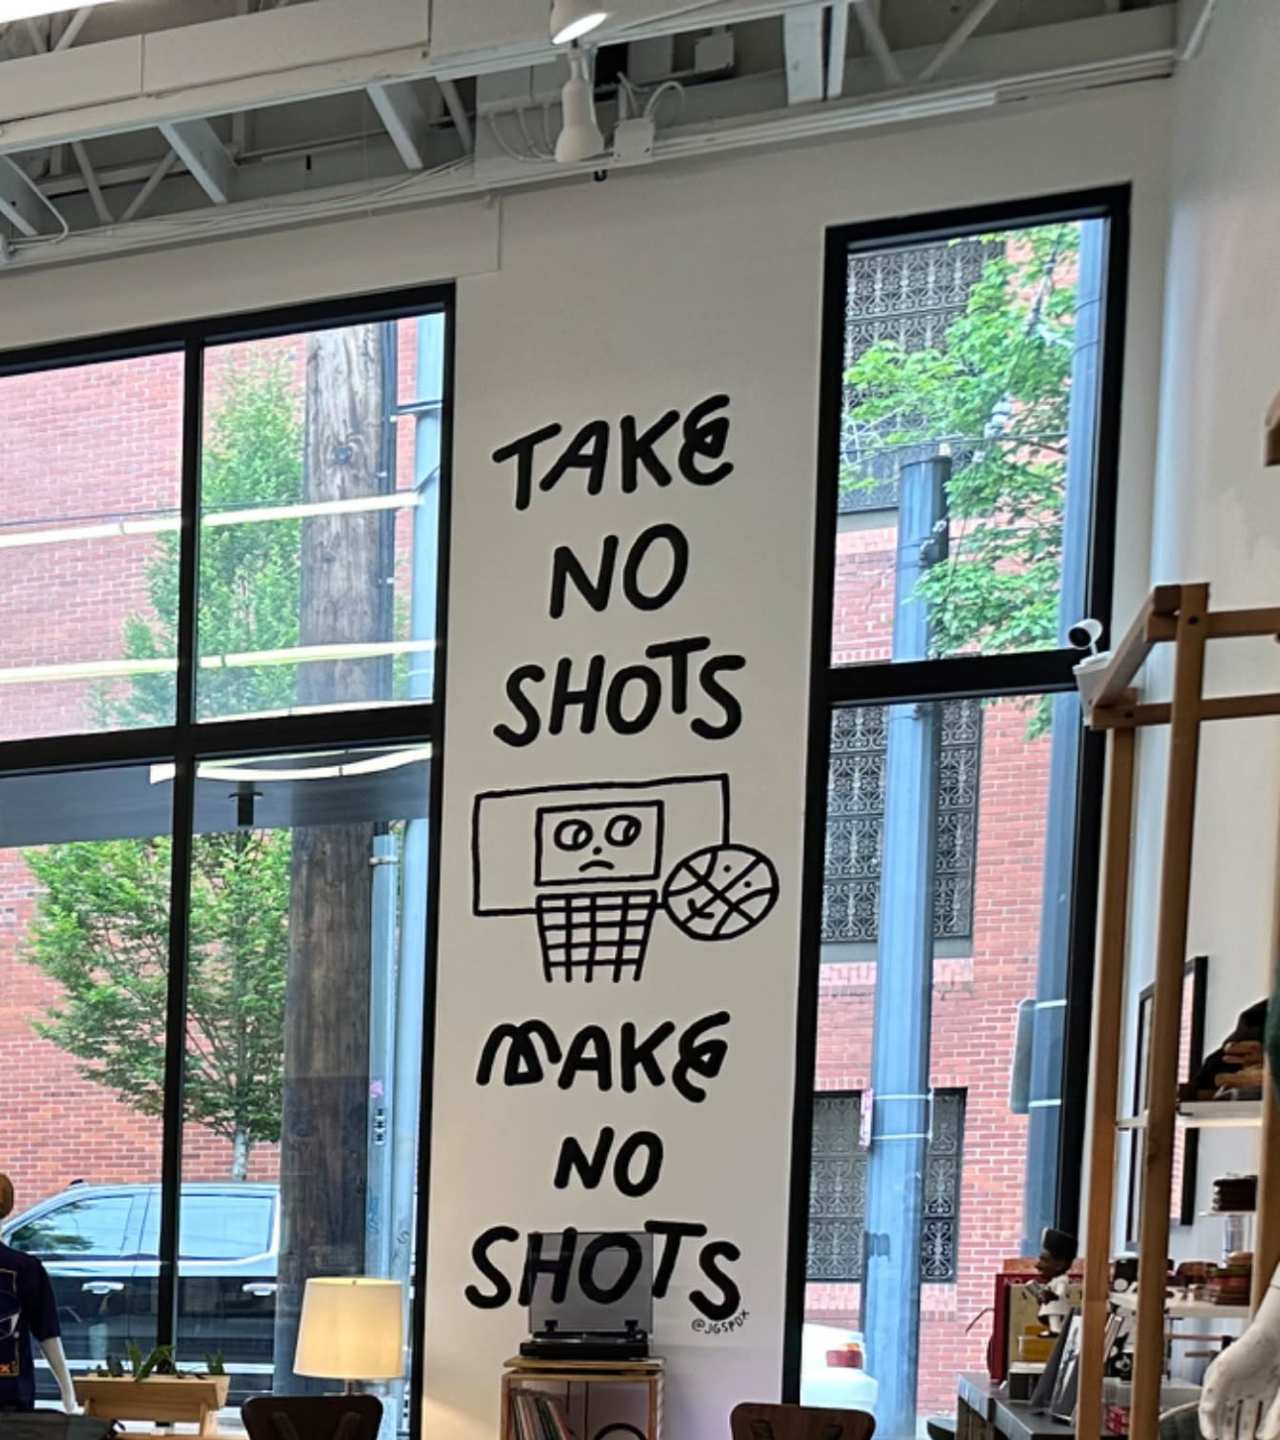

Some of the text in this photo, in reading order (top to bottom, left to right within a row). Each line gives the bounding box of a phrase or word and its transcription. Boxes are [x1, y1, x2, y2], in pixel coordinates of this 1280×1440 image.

[492, 394, 734, 510] TAKE
[550, 523, 689, 619] NO
[493, 636, 746, 747] SHOTS
[476, 1011, 731, 1103] MAKE
[554, 1126, 664, 1197] NO
[465, 1220, 741, 1320] SHOTS
